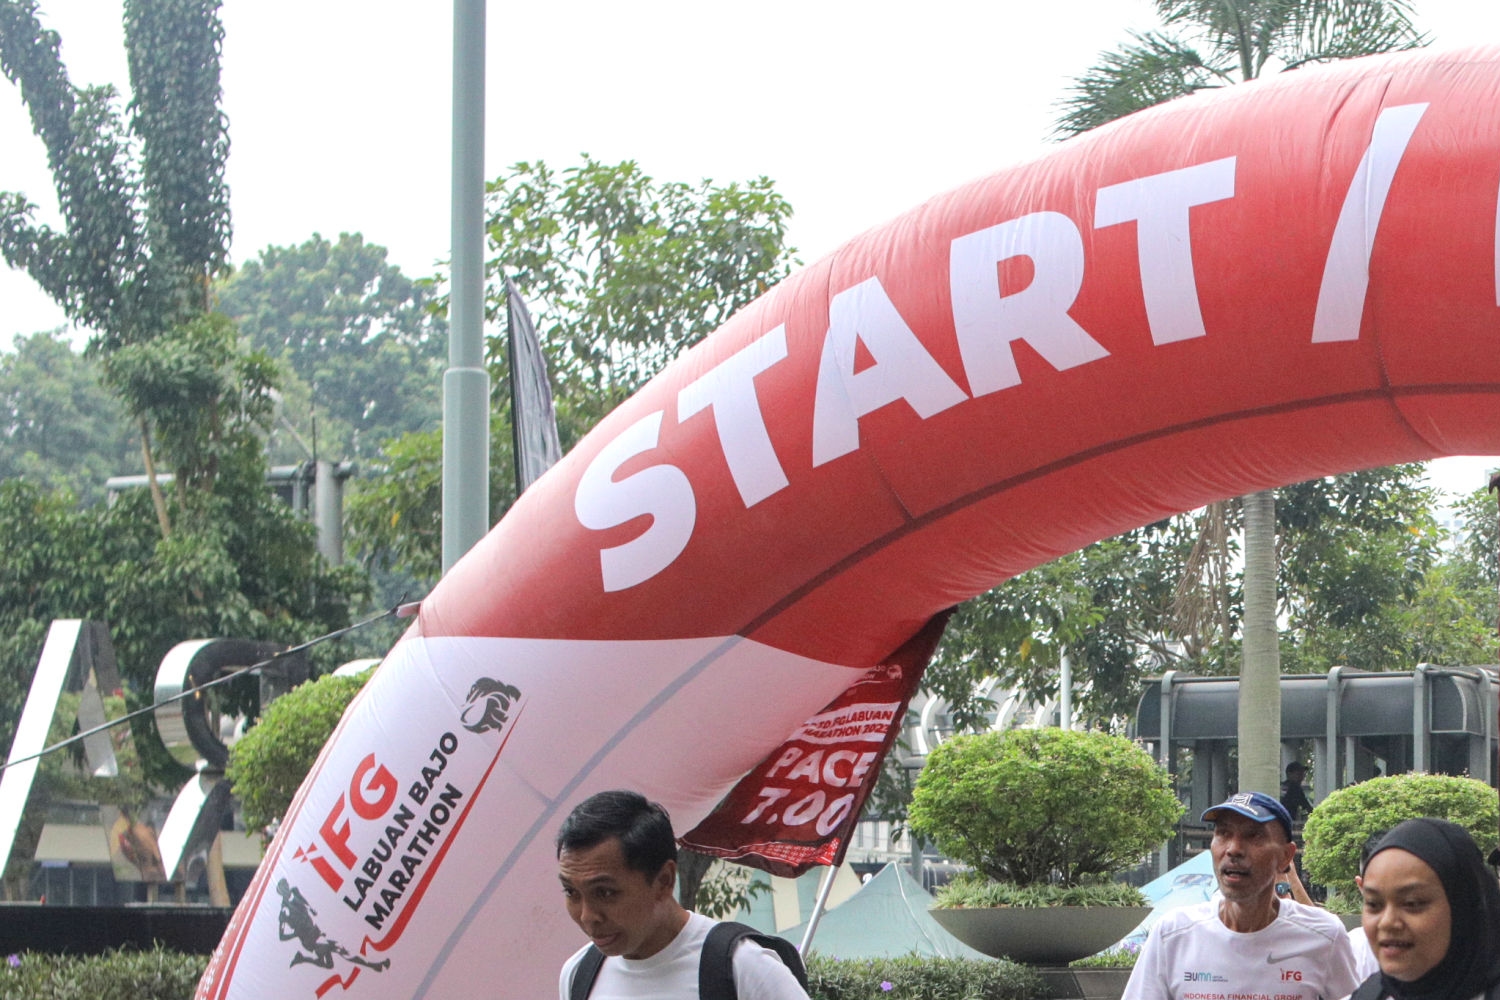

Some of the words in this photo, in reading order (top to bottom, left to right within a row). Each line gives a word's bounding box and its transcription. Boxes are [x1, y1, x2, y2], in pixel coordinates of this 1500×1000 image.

[574, 156, 1236, 592] START
[846, 710, 894, 724] LABUAN
[765, 747, 879, 787] PACE
[343, 803, 415, 912] LABUAN
[408, 732, 458, 806] BAJO
[741, 787, 855, 836] 7.00
[365, 783, 464, 930] MARATHON
[1183, 992, 1225, 1000] INDONESIA
[1228, 993, 1271, 1000] FINANCIAL
